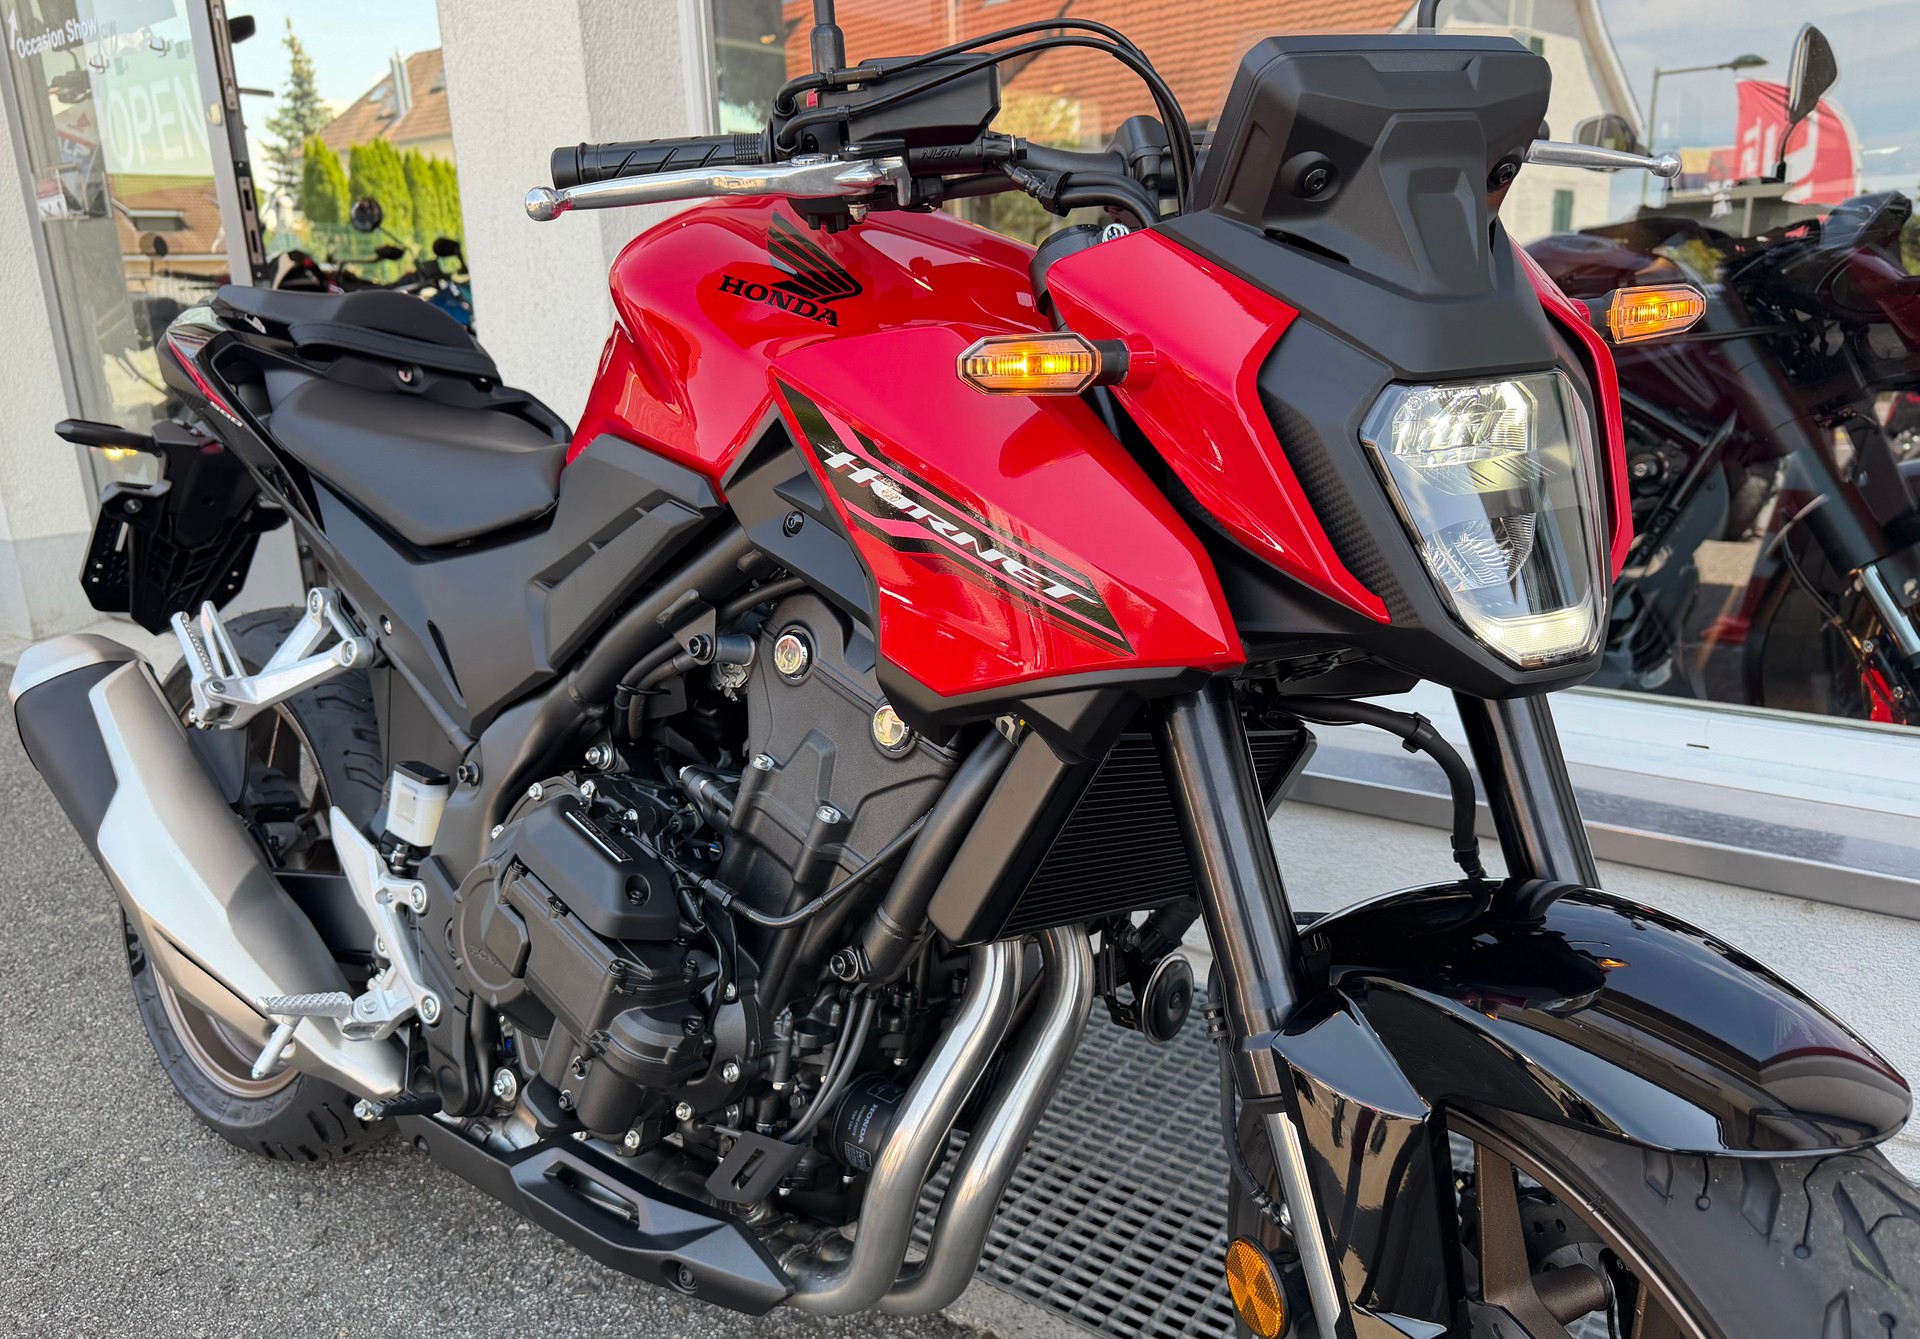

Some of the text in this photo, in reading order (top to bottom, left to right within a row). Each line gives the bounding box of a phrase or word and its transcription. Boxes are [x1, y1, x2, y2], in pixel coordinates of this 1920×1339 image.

[16, 18, 98, 59] Occasion Show
[106, 73, 211, 170] OPEN
[717, 274, 839, 328] HONDA
[817, 442, 1103, 606] HORNET
[858, 1103, 879, 1144] HONDA
